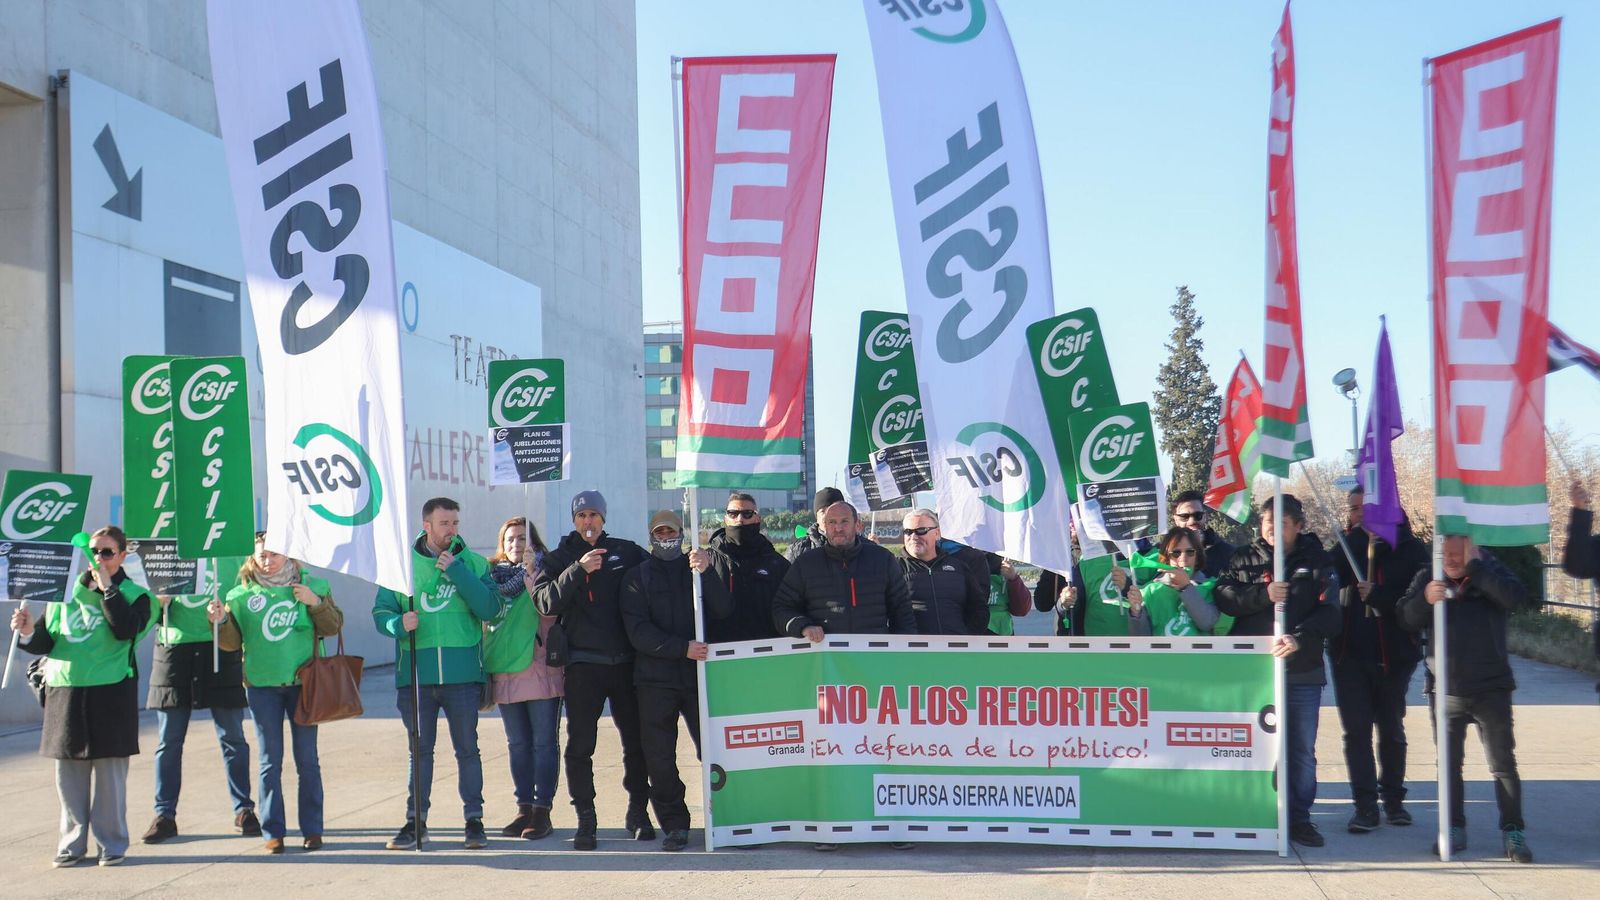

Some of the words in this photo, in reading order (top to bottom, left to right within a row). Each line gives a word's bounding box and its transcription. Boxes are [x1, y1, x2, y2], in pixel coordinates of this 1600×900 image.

[690, 72, 796, 428] CCOO
[1446, 51, 1526, 471] CCOO
[1051, 330, 1094, 360] CSIF
[504, 386, 556, 408] CSIF
[882, 408, 923, 433] CSIF
[513, 439, 561, 447] JUBILACIONES
[514, 447, 561, 456] ANTICIPADAS
[1092, 432, 1145, 461] CSIF
[522, 456, 559, 464] PARCIALES
[17, 498, 78, 522] CSIF
[817, 685, 868, 725] ¡NO
[877, 685, 900, 726] A
[908, 685, 968, 726] LOS
[976, 686, 1148, 728] RECORTES!
[768, 744, 805, 756] Granada
[811, 738, 844, 759] ¡En
[855, 733, 953, 761] defensa
[965, 737, 997, 758] de
[1009, 739, 1035, 758] lo
[1047, 736, 1148, 768] público!
[1211, 747, 1252, 758] Granada
[876, 784, 948, 806] CETURSA
[952, 785, 1009, 807] SIERRA
[1013, 786, 1077, 808] NEVADA
